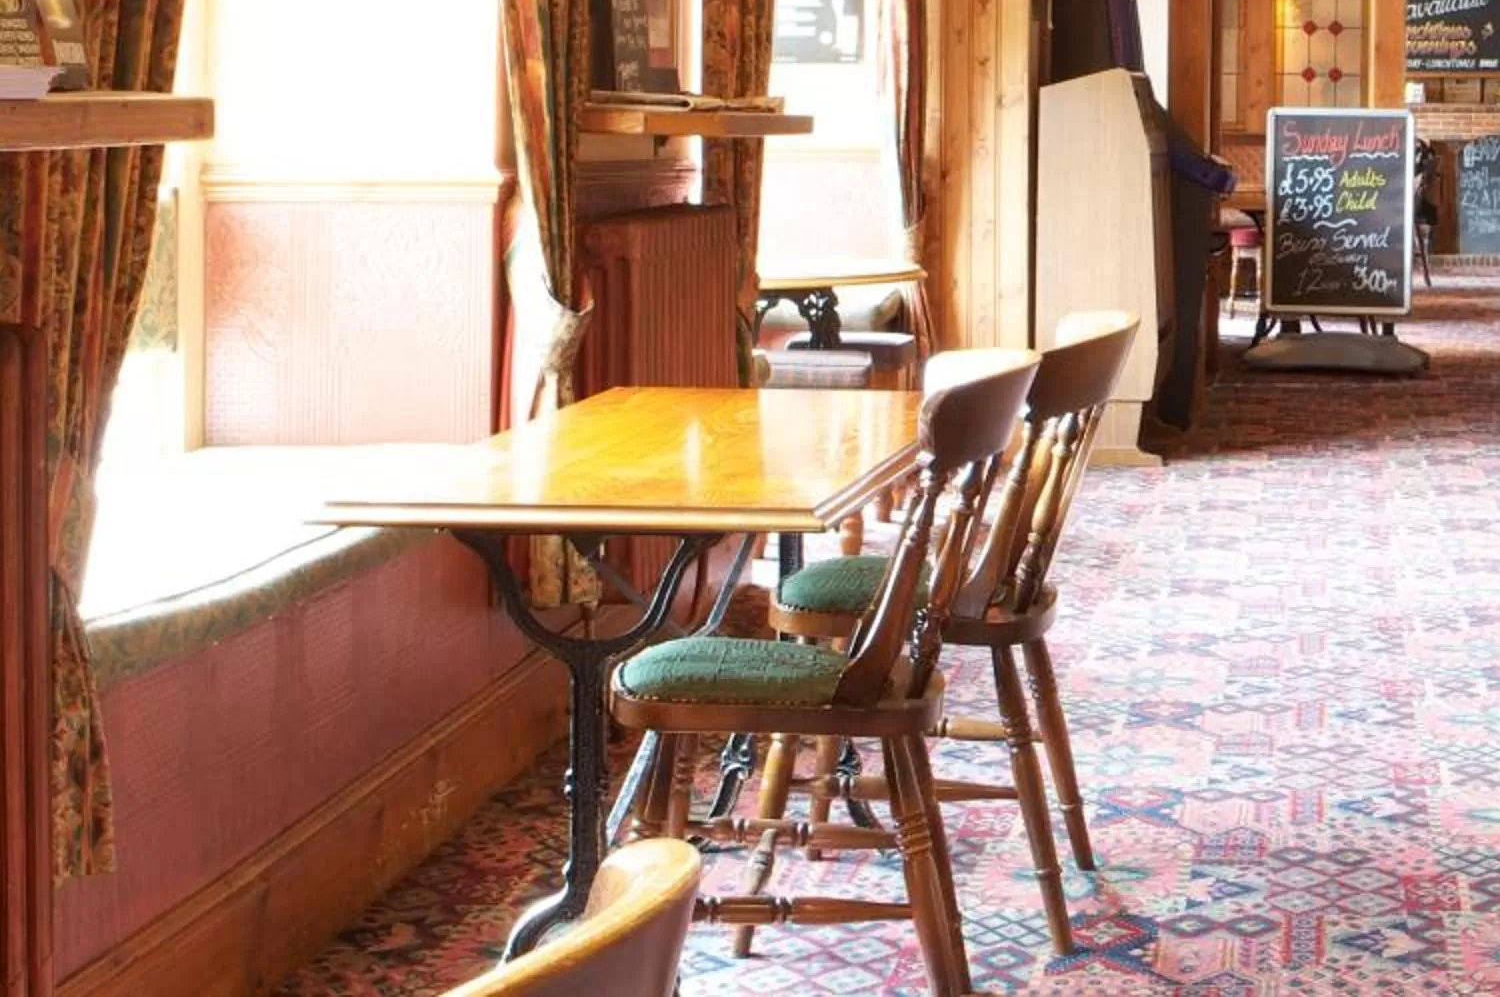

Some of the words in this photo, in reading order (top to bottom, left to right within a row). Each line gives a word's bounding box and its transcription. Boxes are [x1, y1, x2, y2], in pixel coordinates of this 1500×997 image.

[1281, 120, 1349, 168] Sunday
[1352, 119, 1403, 152] Lunch
[1339, 167, 1387, 188] Adults
[1336, 190, 1379, 214] Child
[1331, 226, 1391, 253] Served
